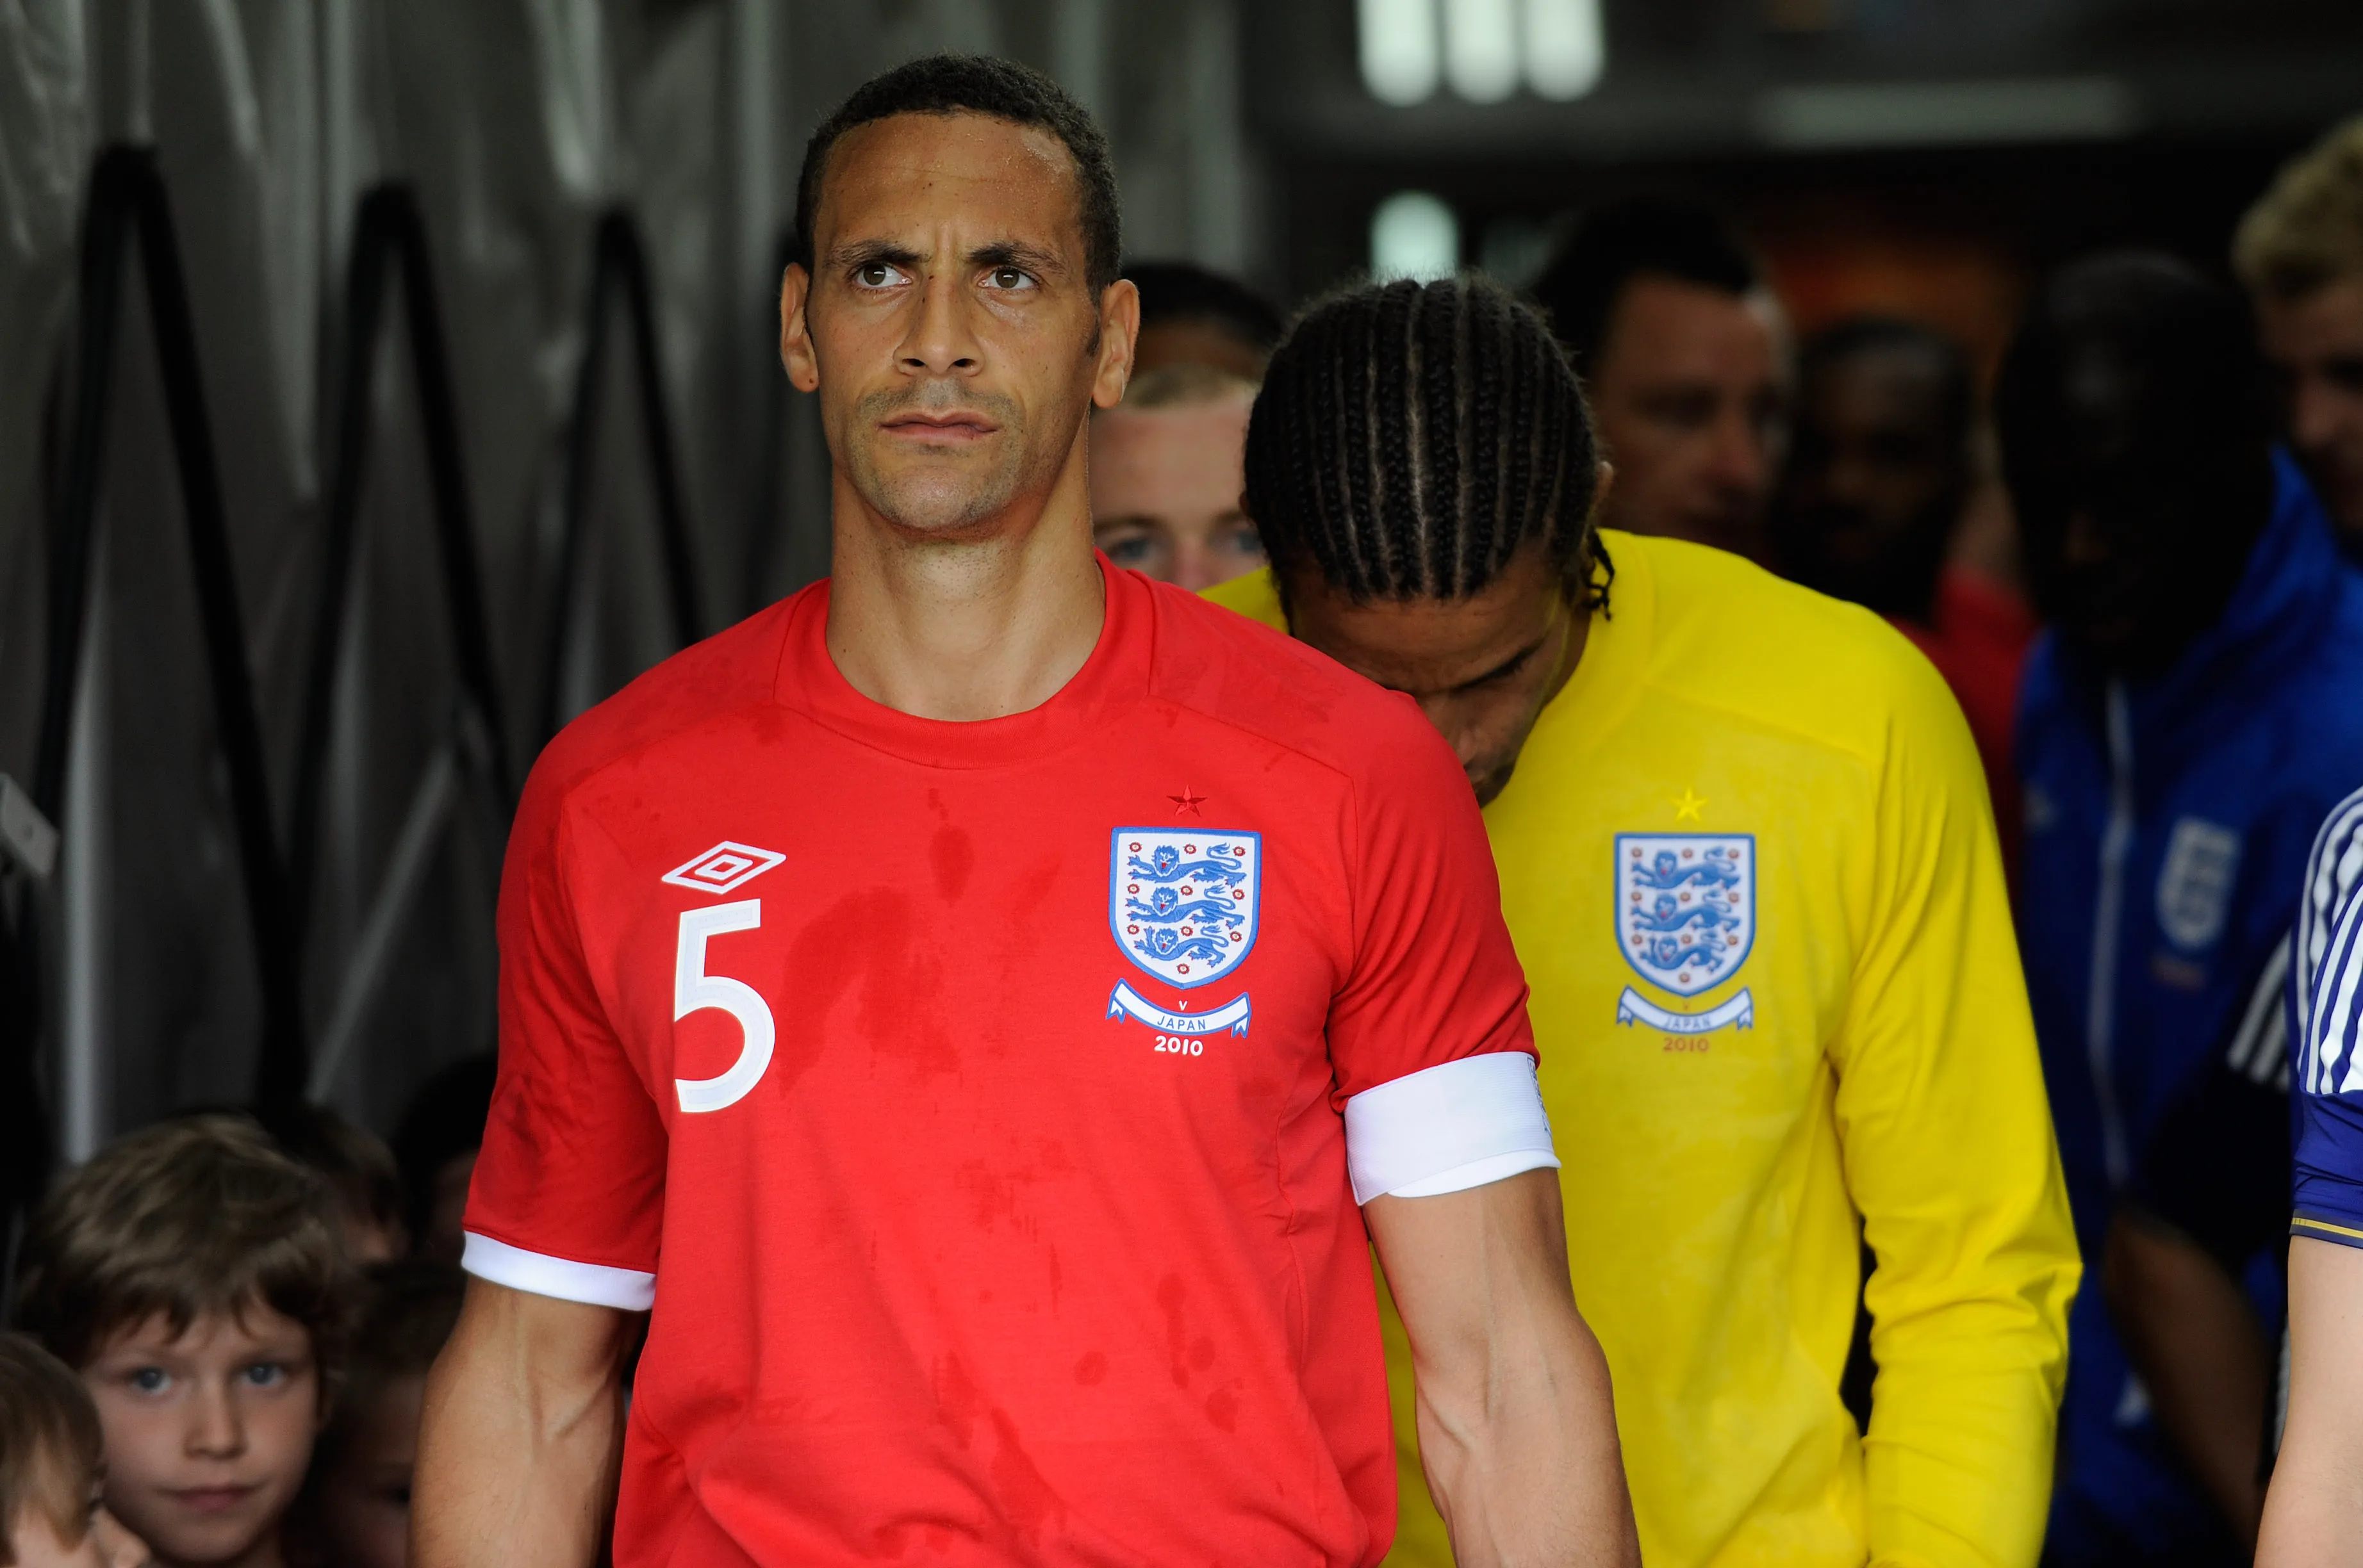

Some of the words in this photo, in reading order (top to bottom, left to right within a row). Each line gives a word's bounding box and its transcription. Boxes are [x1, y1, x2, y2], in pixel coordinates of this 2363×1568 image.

[675, 898, 775, 1113] 5
[1157, 1015, 1206, 1031] JAPAN
[1154, 1035, 1203, 1056] 2010
[1663, 1036, 1709, 1052] 2010
